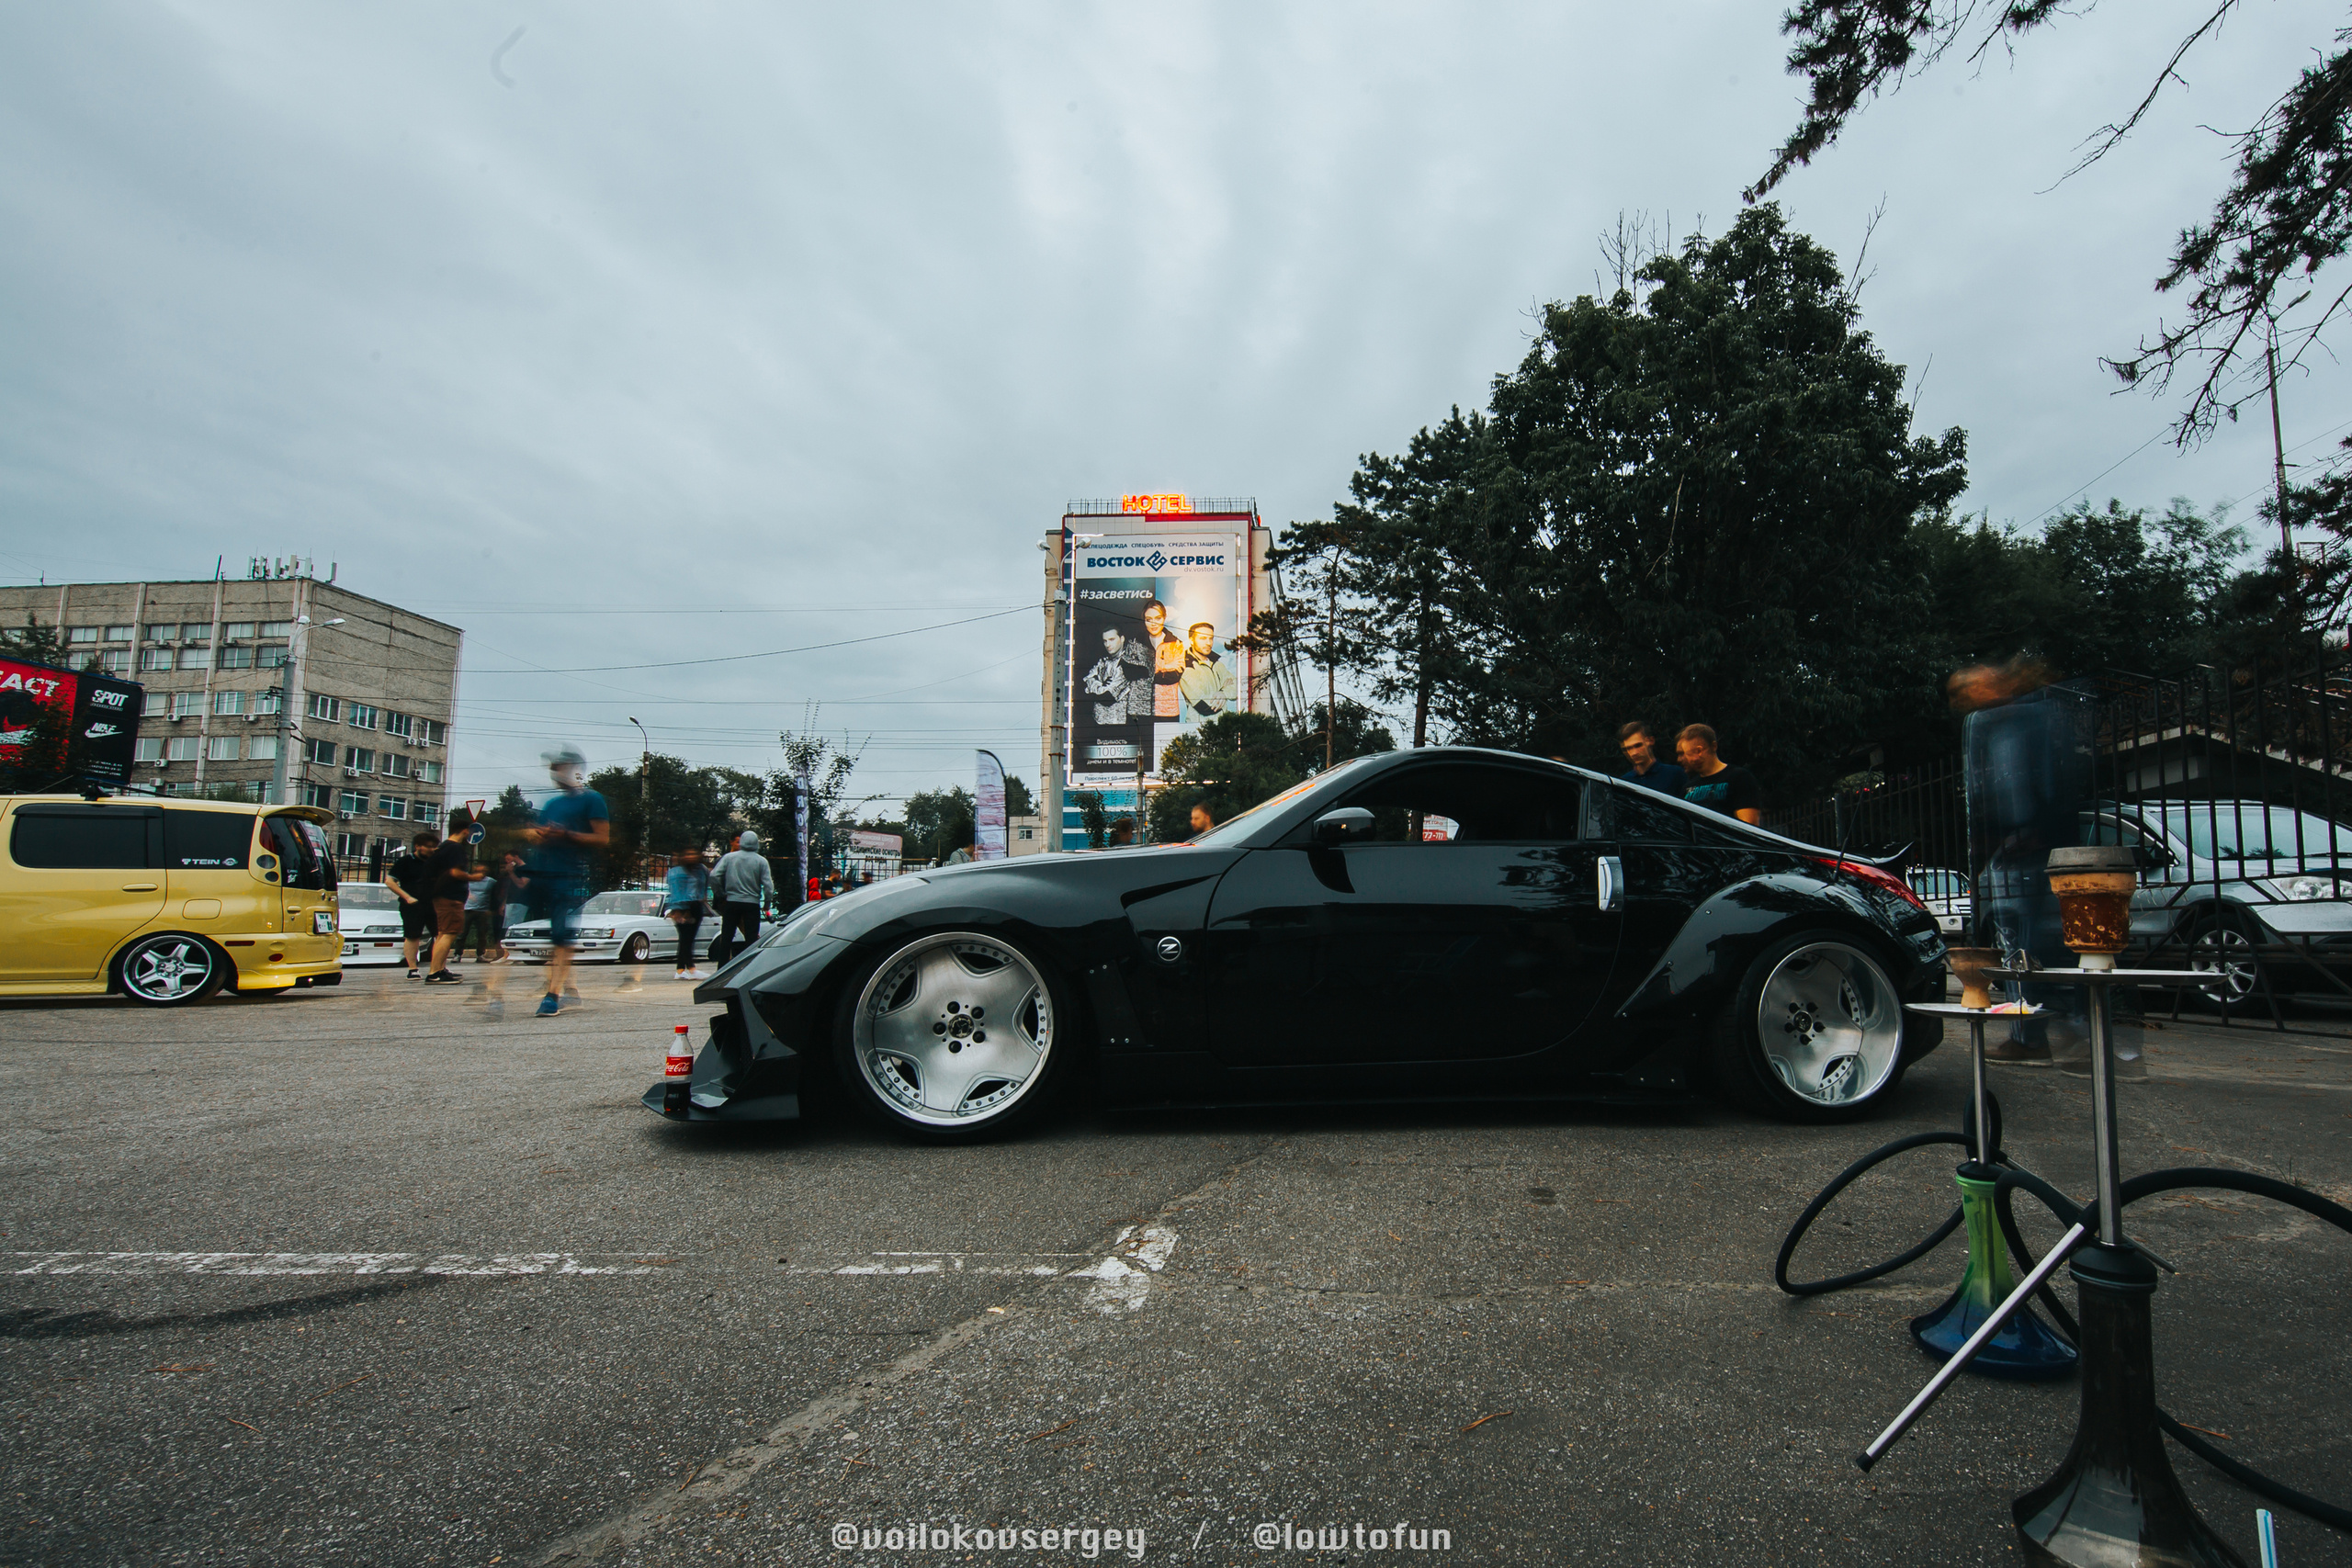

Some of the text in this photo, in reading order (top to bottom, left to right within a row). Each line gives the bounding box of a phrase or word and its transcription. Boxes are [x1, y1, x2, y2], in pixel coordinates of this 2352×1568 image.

[1123, 494, 1192, 512] HOTEL
[1087, 555, 1225, 568] ВОСТОК СЕРВИС
[1080, 589, 1153, 600] #засветись
[0, 671, 60, 697] ACT
[92, 689, 130, 706] SPOT
[91, 722, 118, 733] NIKE
[1097, 747, 1127, 757] 100%
